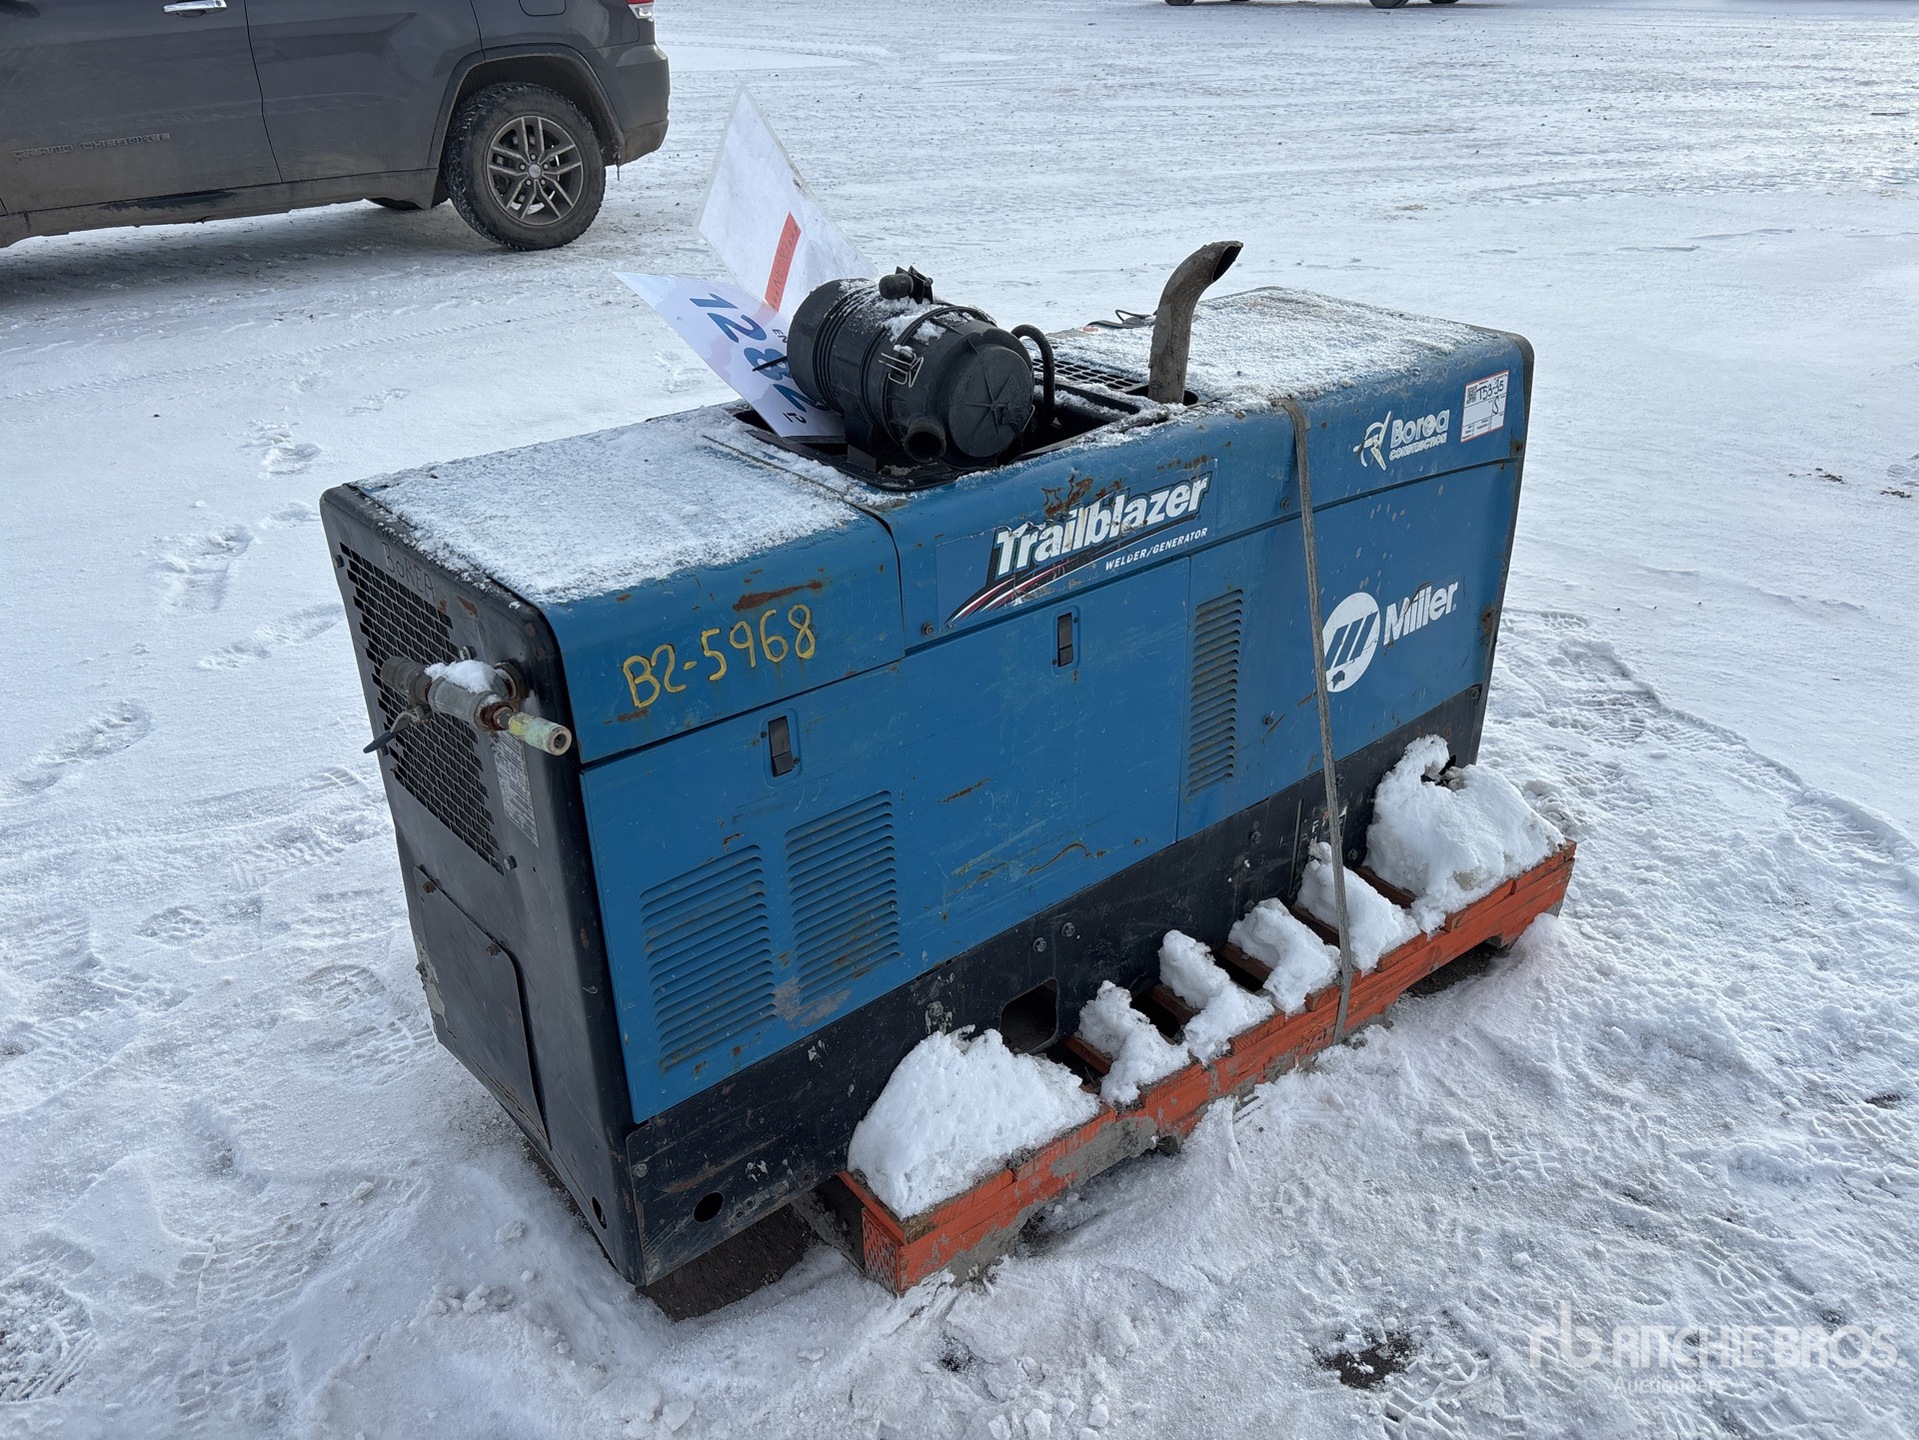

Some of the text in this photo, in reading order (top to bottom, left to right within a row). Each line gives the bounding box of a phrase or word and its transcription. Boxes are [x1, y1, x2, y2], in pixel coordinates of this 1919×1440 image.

[11, 132, 172, 159] GRAND CHEROKEE
[1389, 432, 1448, 461] CONSTRUCTION
[1390, 409, 1450, 448] Borea
[994, 474, 1211, 578] Trailblazer
[1105, 527, 1208, 571] WELDER/GENERATOR
[1383, 580, 1459, 646] Miller
[621, 603, 817, 709] B2-5968
